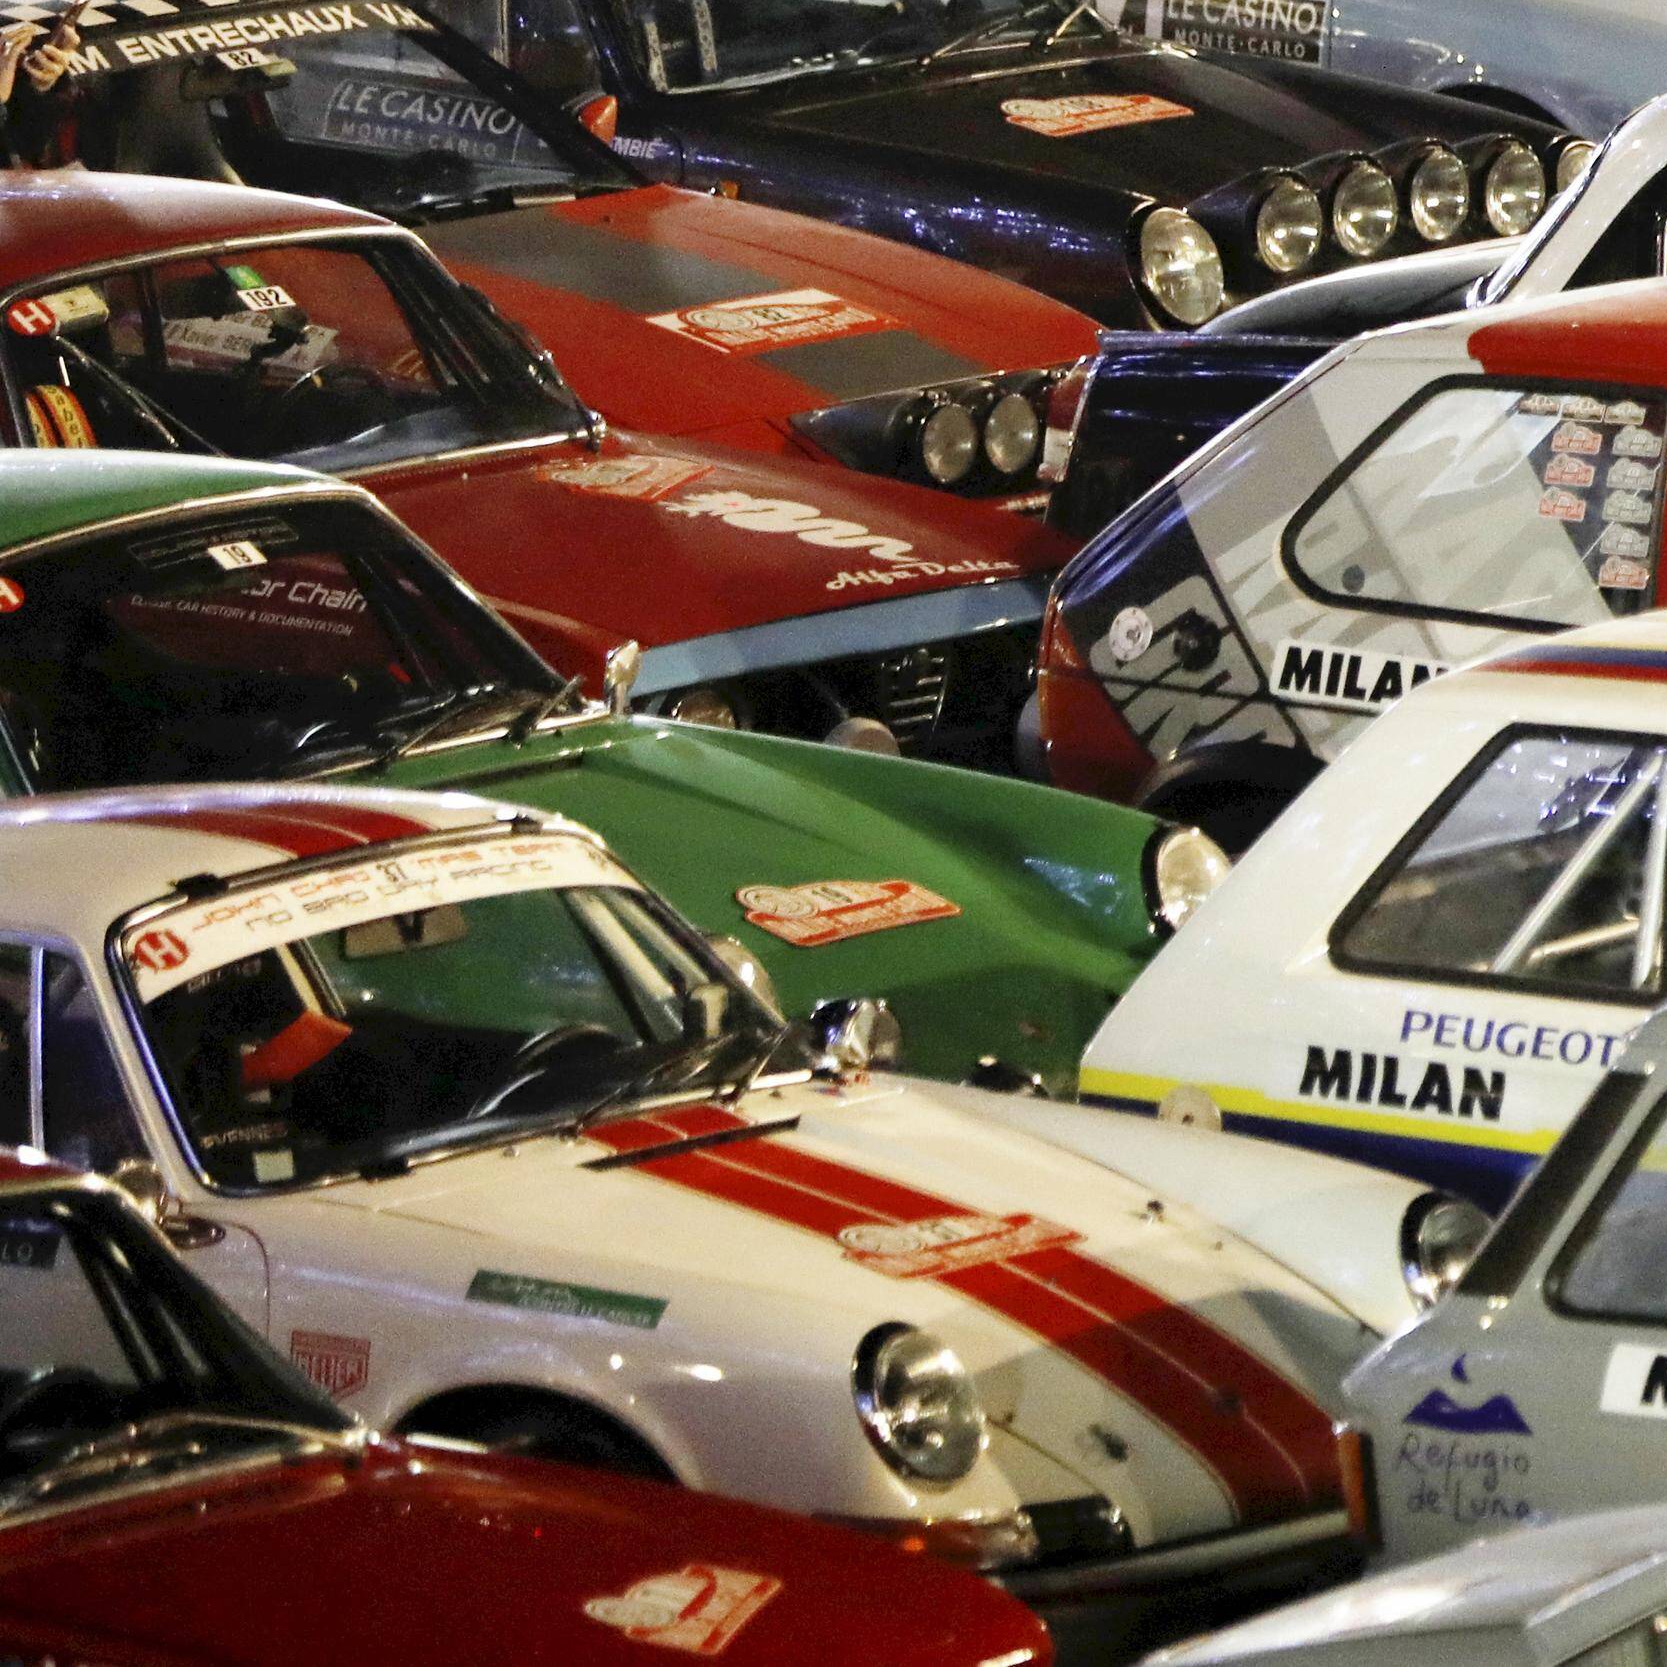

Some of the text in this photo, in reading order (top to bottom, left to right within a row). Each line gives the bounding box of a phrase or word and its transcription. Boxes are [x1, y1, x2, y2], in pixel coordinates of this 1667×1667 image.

[124, 4, 362, 66] ENTRECHAUX
[1174, 30, 1307, 59] MONTE CARLO
[230, 49, 258, 68] 82
[334, 82, 518, 138] LE CASINO
[245, 287, 288, 309] 192
[11, 301, 52, 333] H
[224, 543, 252, 565] 19
[200, 603, 246, 620] HISTORY
[288, 581, 368, 615] Chain
[1281, 645, 1449, 705] MILAN
[139, 930, 188, 971] H
[1400, 1008, 1621, 1068] PEUGEOT
[1299, 1044, 1506, 1122] MILAN
